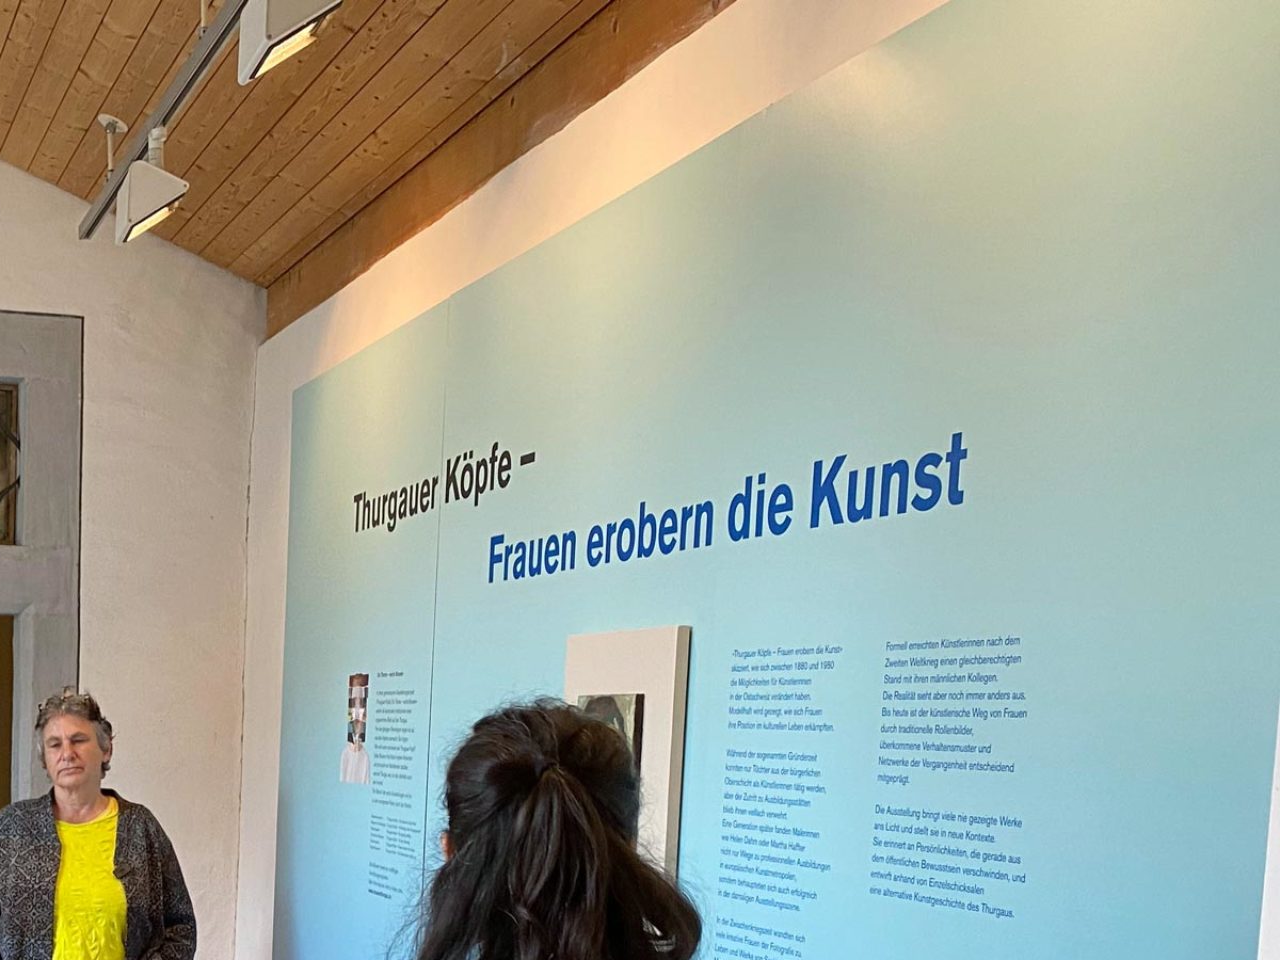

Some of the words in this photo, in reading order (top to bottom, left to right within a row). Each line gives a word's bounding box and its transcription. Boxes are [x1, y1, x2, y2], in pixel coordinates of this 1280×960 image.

[354, 476, 438, 532] Thurgauer
[445, 442, 512, 506] Köpfe
[488, 530, 576, 583] Frauen
[586, 500, 714, 567] erobern
[728, 472, 793, 542] die
[810, 432, 968, 528] Kunst
